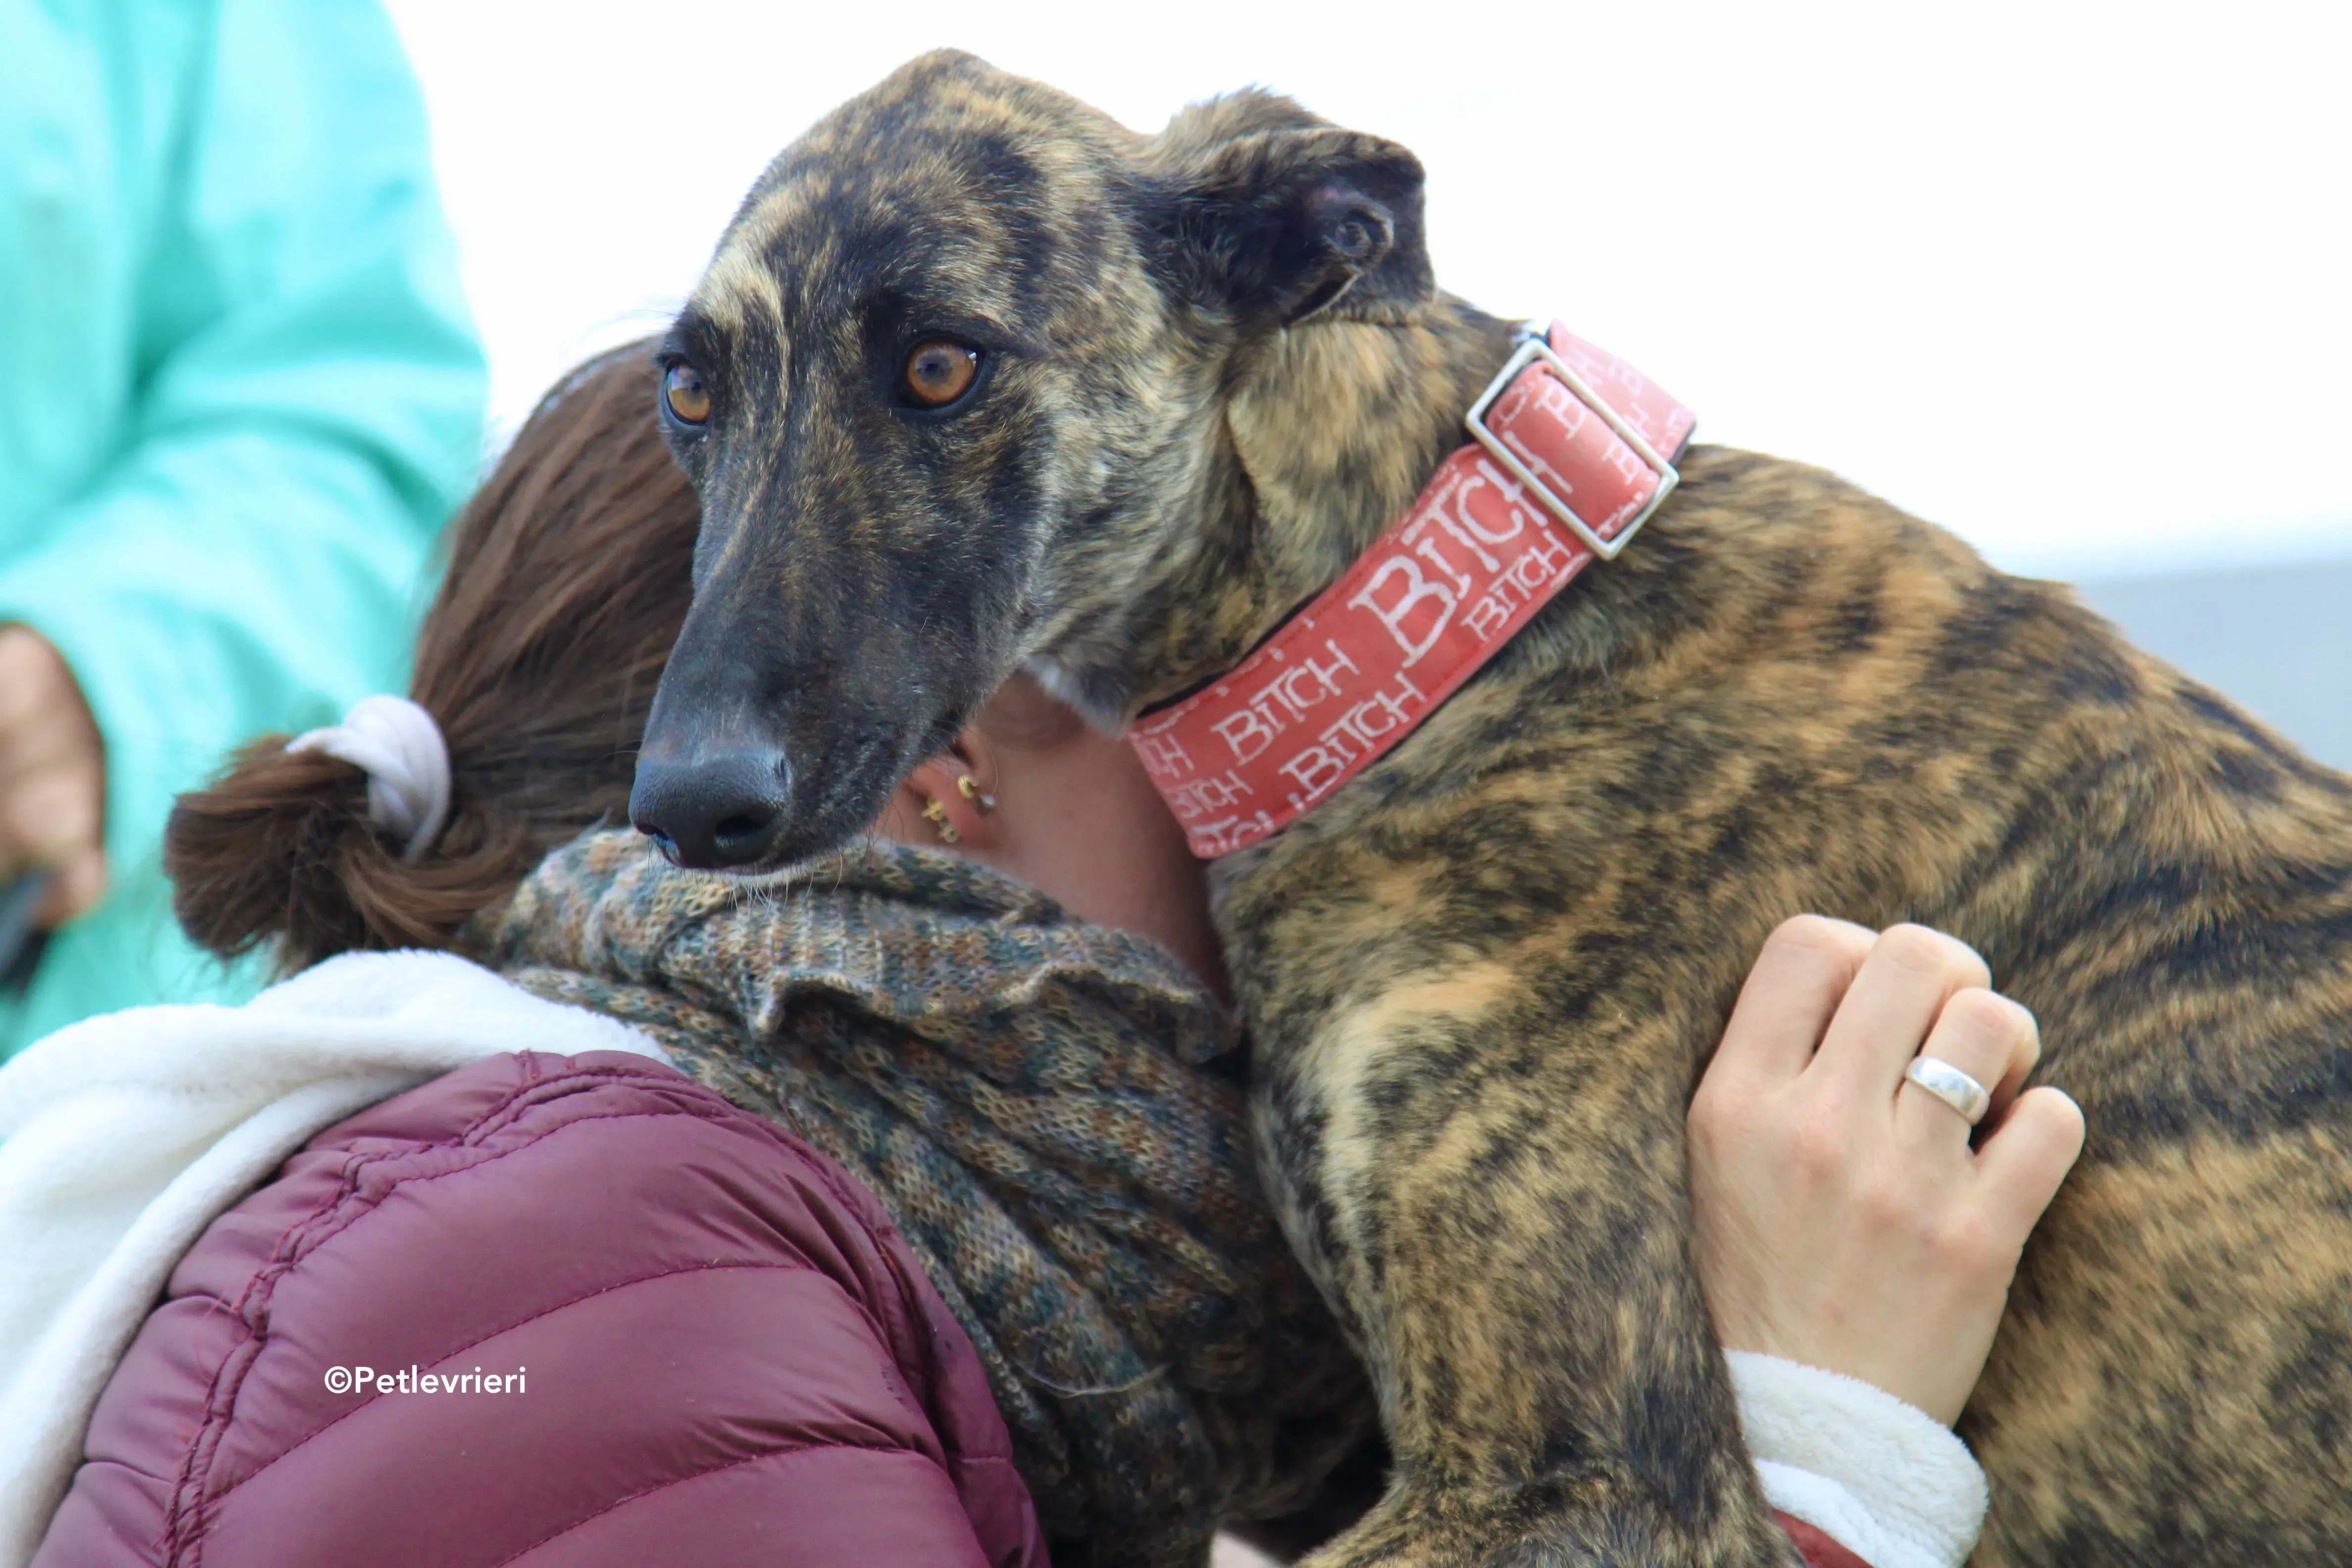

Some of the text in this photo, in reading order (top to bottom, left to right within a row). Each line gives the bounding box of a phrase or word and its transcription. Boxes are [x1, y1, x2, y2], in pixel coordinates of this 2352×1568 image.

[1346, 431, 1574, 669] BITCH
[1460, 529, 1572, 641] BITCH
[1210, 638, 1361, 766] BITCH
[1278, 671, 1427, 801] BITCH
